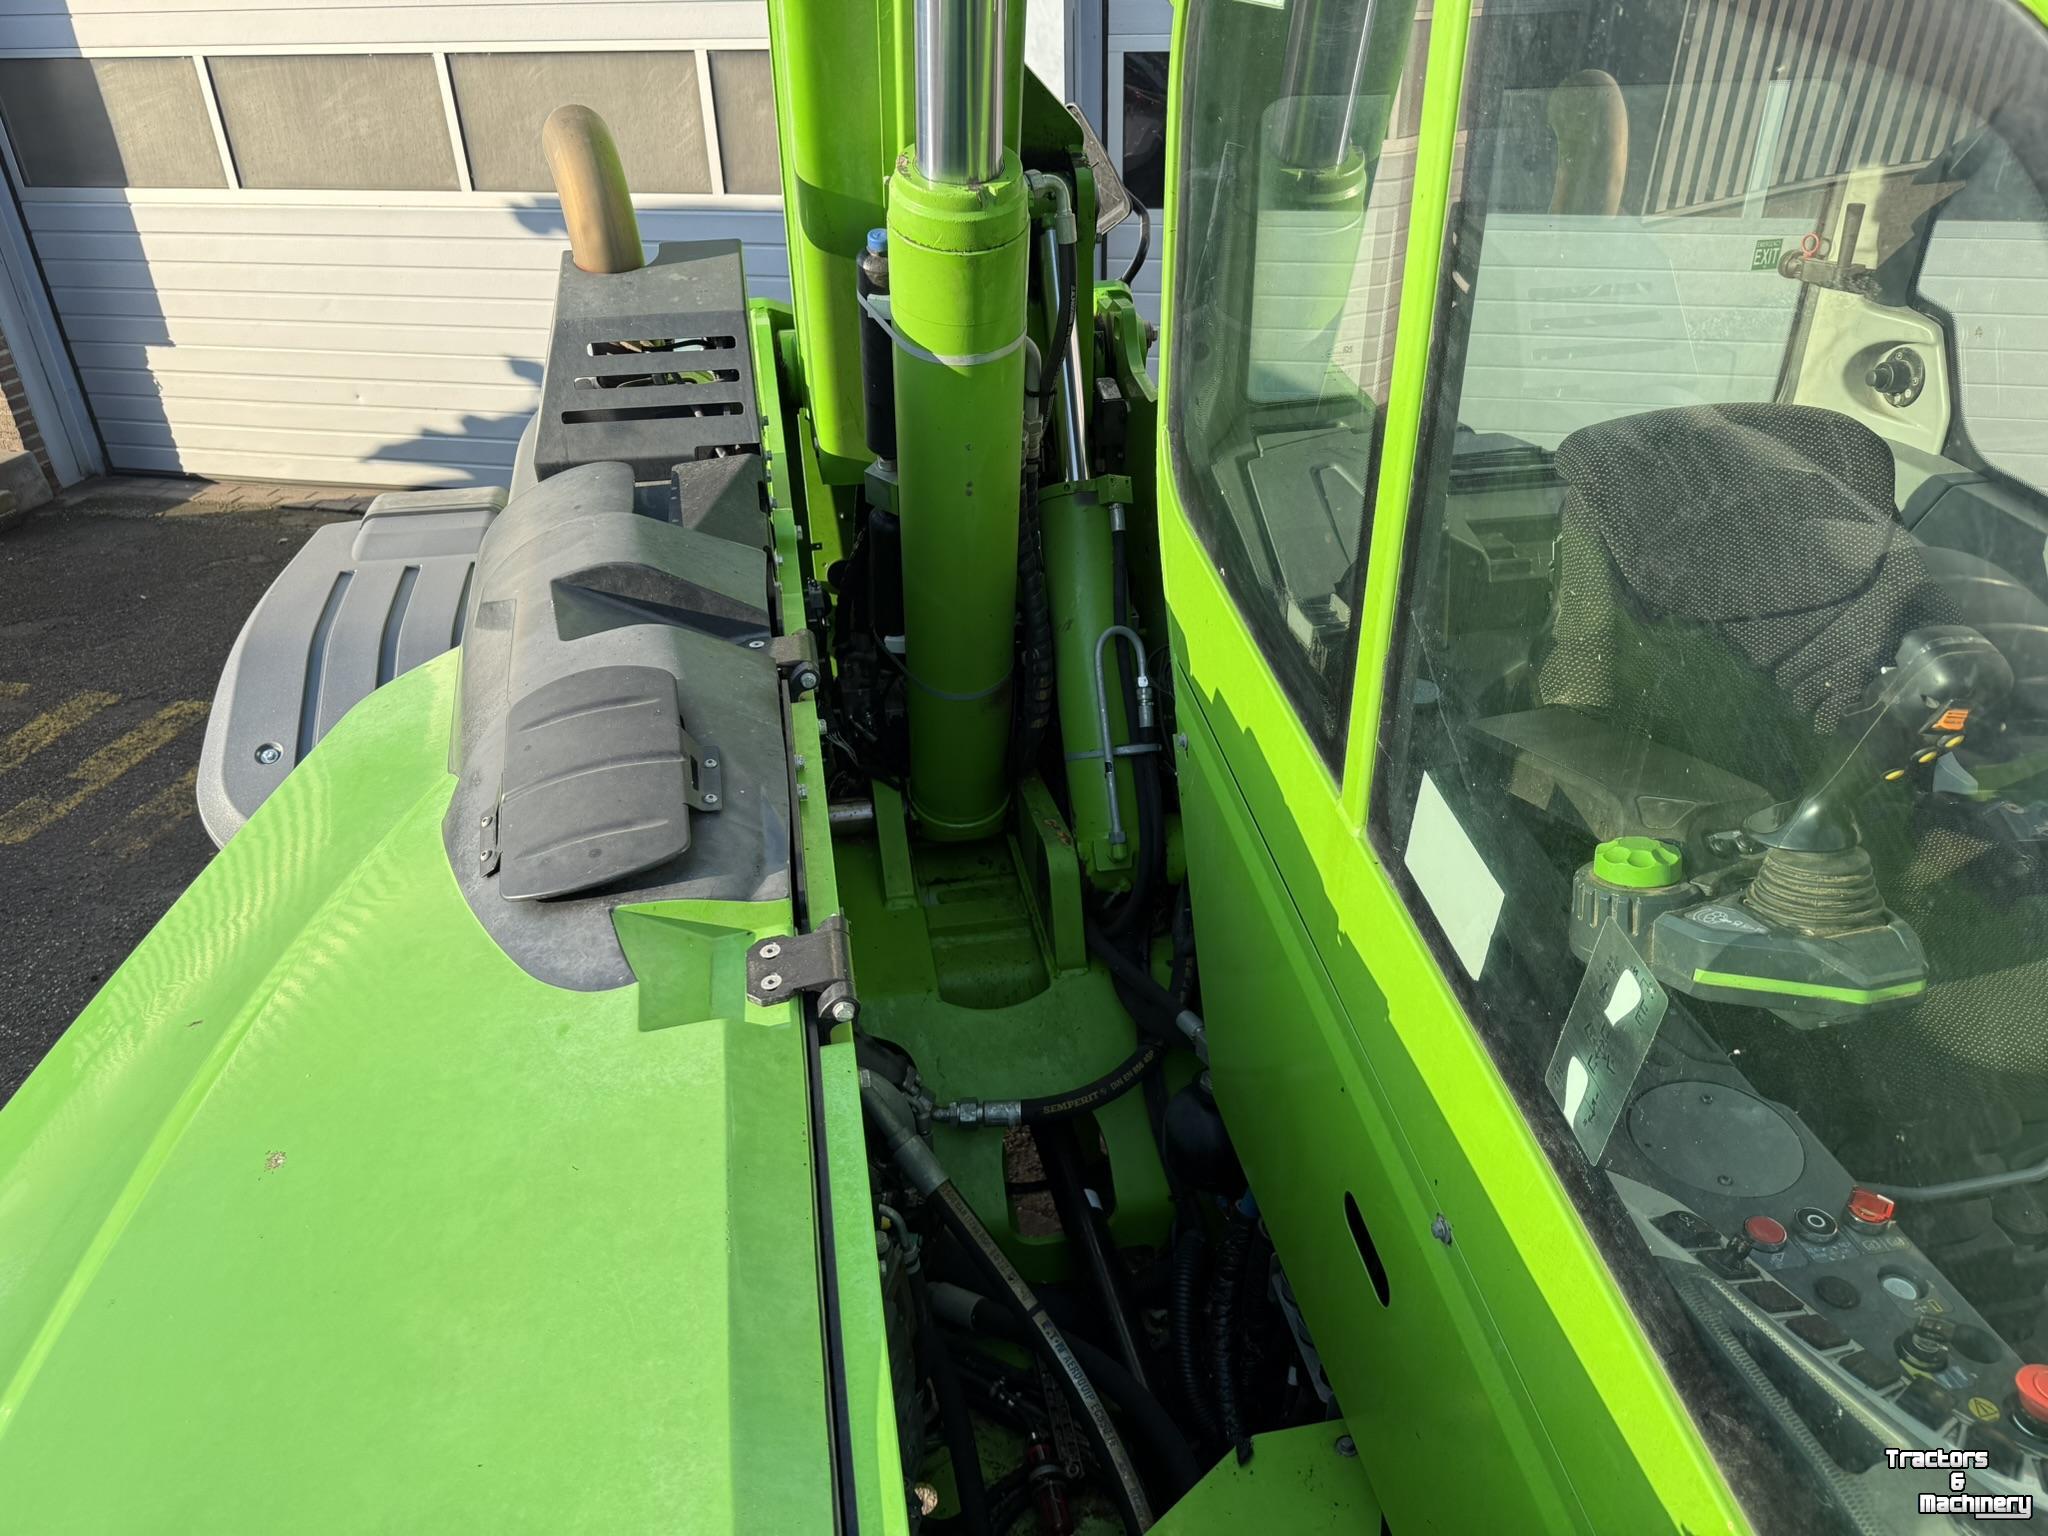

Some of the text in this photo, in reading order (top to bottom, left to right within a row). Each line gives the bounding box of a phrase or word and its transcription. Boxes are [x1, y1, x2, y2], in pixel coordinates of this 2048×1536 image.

[1753, 247, 1780, 265] EXIT
[1043, 1090, 1100, 1114] SEMPERIT
[1063, 1355, 1097, 1401] AEROQUIP
